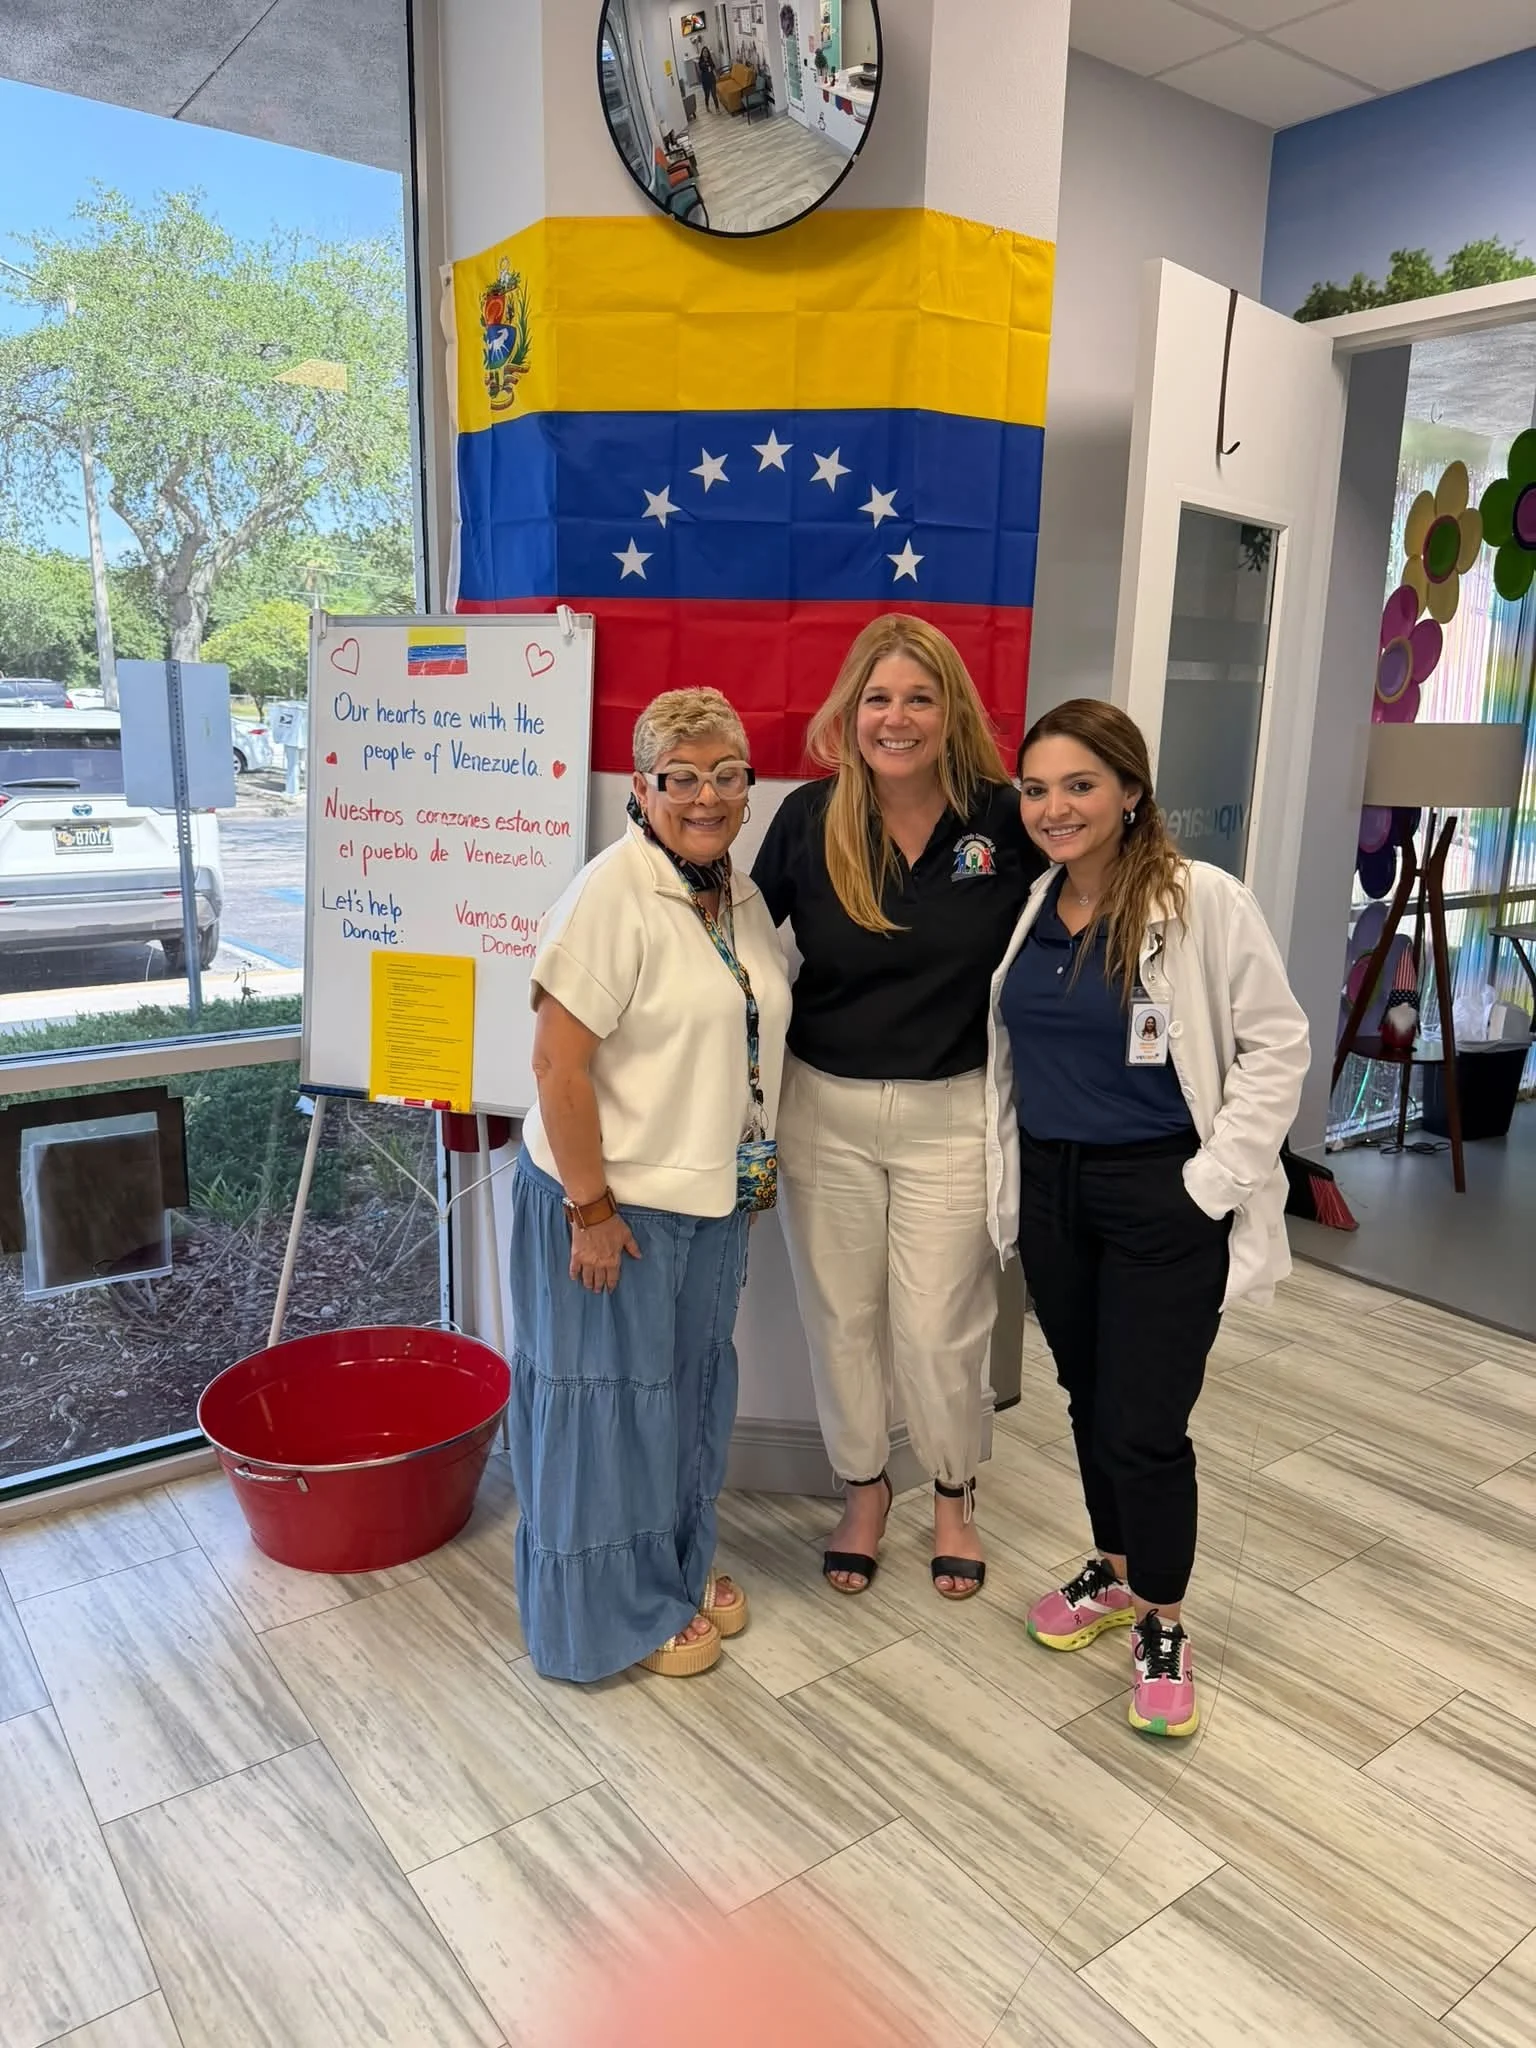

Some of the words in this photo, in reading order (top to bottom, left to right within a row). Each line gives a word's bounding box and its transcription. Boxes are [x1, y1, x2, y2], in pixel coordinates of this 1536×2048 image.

[334, 692, 370, 721] Our
[376, 698, 426, 725] hearts
[433, 710, 462, 728] are
[470, 701, 507, 731] with
[514, 702, 545, 735] the
[364, 741, 417, 771] people
[424, 743, 442, 774] of
[451, 739, 543, 776] Venezuela.
[324, 787, 404, 825] Nuestros
[416, 808, 491, 830] corazones
[495, 809, 542, 834] estan
[545, 818, 572, 837] con
[339, 840, 354, 858] el
[363, 842, 418, 877] pueblo
[430, 838, 449, 862] de
[464, 839, 552, 868] Venezuela.
[322, 887, 365, 913] Let's
[368, 890, 403, 924] help
[455, 899, 508, 929] Vamos
[511, 911, 546, 941] ayu
[342, 918, 404, 945] Donate:
